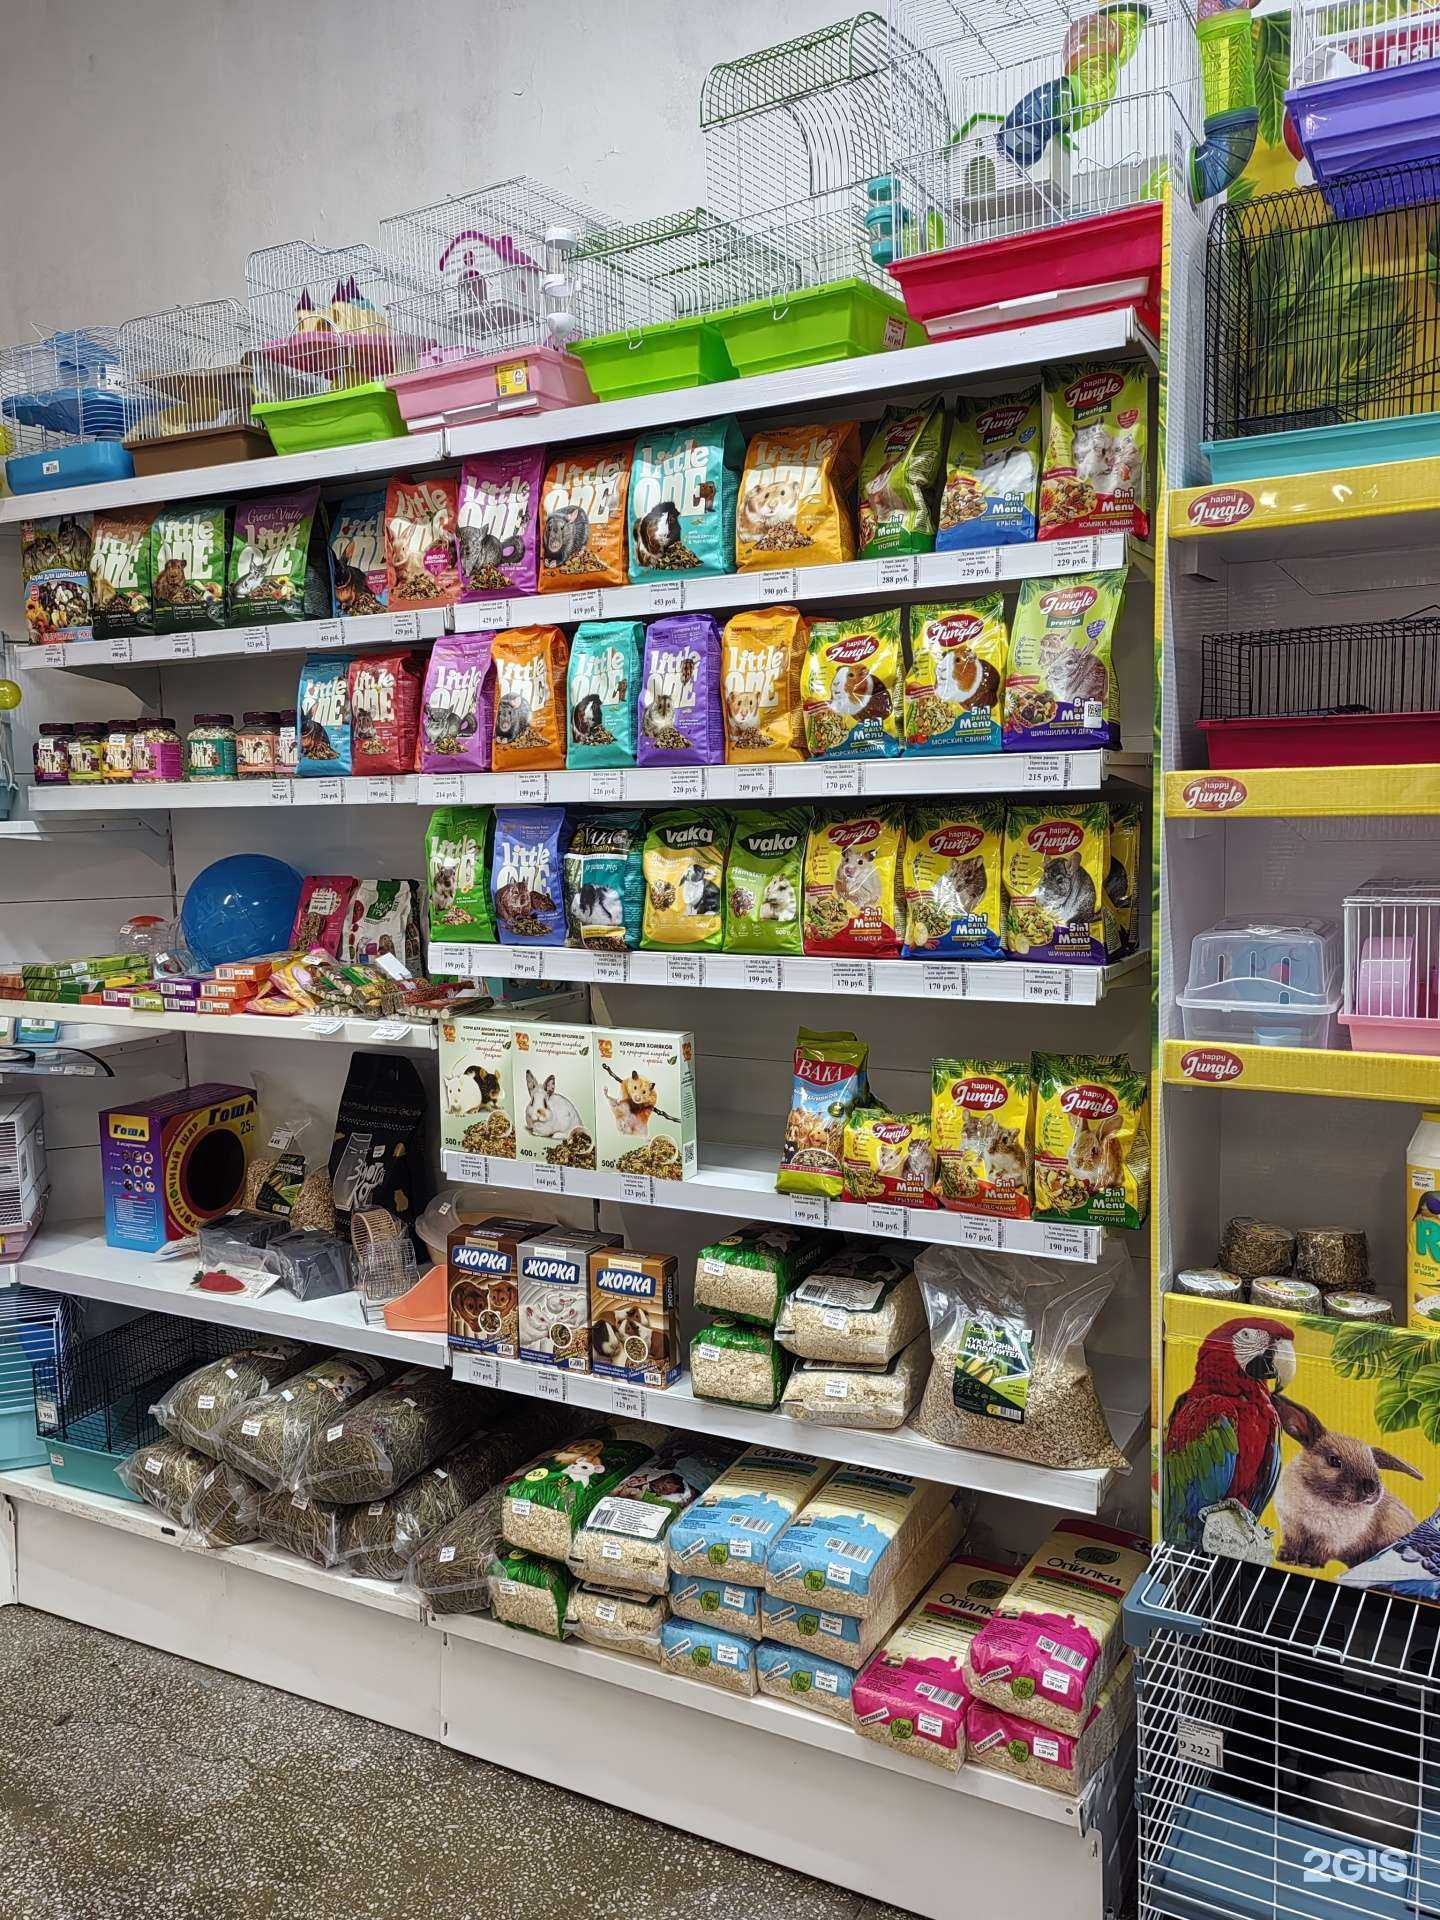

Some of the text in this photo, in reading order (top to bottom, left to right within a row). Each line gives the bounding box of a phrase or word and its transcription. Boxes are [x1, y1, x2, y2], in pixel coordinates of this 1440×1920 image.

[1067, 381, 1121, 407] Jungle
[977, 409, 1026, 433] Jungle
[640, 440, 709, 479] Little
[754, 437, 833, 466] Little
[551, 454, 620, 489] Little
[465, 475, 531, 503] Little
[1003, 491, 1025, 502] 8in1
[394, 484, 449, 519] Little
[1101, 502, 1135, 512] Menu
[1210, 494, 1237, 504] happy
[992, 504, 1024, 514] Menu
[1190, 499, 1250, 526] Jungle
[157, 515, 214, 545] Little
[336, 510, 387, 539] Littl
[95, 530, 144, 554] Little
[244, 521, 300, 550] Little
[1071, 557, 1088, 567] руб.
[895, 576, 910, 585] руб.
[976, 567, 992, 577] руб.
[1041, 594, 1094, 616] Jungle
[930, 623, 984, 643] Jungle
[576, 646, 625, 678] Little
[650, 646, 701, 674] Little
[728, 646, 785, 672] Little
[826, 644, 877, 662] Jungle
[496, 653, 545, 681] Little
[354, 668, 395, 690] Little
[435, 665, 482, 690] Little
[303, 676, 347, 700] Little
[959, 719, 991, 729] Menu
[853, 731, 884, 740] Menu
[931, 735, 992, 745] МОРСКИЕ СВИНКИ
[1043, 773, 1060, 782] руб.
[1204, 781, 1230, 791] happy
[684, 785, 698, 794] руб.
[750, 784, 765, 792] руб.
[1185, 786, 1244, 809] Jungle
[748, 833, 798, 851] vaka
[830, 825, 878, 844] Jungle
[931, 834, 980, 852] Jungle
[1032, 831, 1081, 852] Jungle
[501, 842, 551, 866] Little
[853, 919, 882, 929] Menu
[956, 925, 988, 936] Menu
[1068, 922, 1089, 932] 5in1
[1058, 935, 1090, 944] Menu
[837, 979, 865, 988] 170 руб.
[942, 983, 958, 991] руб.
[1044, 987, 1060, 996] руб.
[1201, 1052, 1227, 1063] happy
[1182, 1055, 1240, 1079] Jungle
[971, 1082, 994, 1091] happy
[1082, 1090, 1105, 1099] happy
[954, 1087, 1004, 1107] Jungle
[1063, 1093, 1114, 1117] Jungle
[872, 1125, 910, 1140] Jungle
[906, 1173, 924, 1181] 5in1
[896, 1183, 924, 1192] Menu
[984, 1190, 1016, 1199] Menu
[1104, 1188, 1125, 1197] 5in1
[1092, 1199, 1125, 1209] Menu
[885, 1222, 899, 1231] руб.
[1089, 1215, 1126, 1223] КРОЛИКИ
[964, 1232, 994, 1243] 167 руб.
[1049, 1243, 1080, 1254] 190 руб.
[454, 1248, 508, 1271] ЖОРКА
[524, 1259, 576, 1282] ЖОРКА
[598, 1270, 652, 1294] ЖОРКА
[1047, 1557, 1121, 1586] Опилки
[939, 1593, 999, 1619] Опилк
[1179, 1740, 1211, 1758] 9 222
